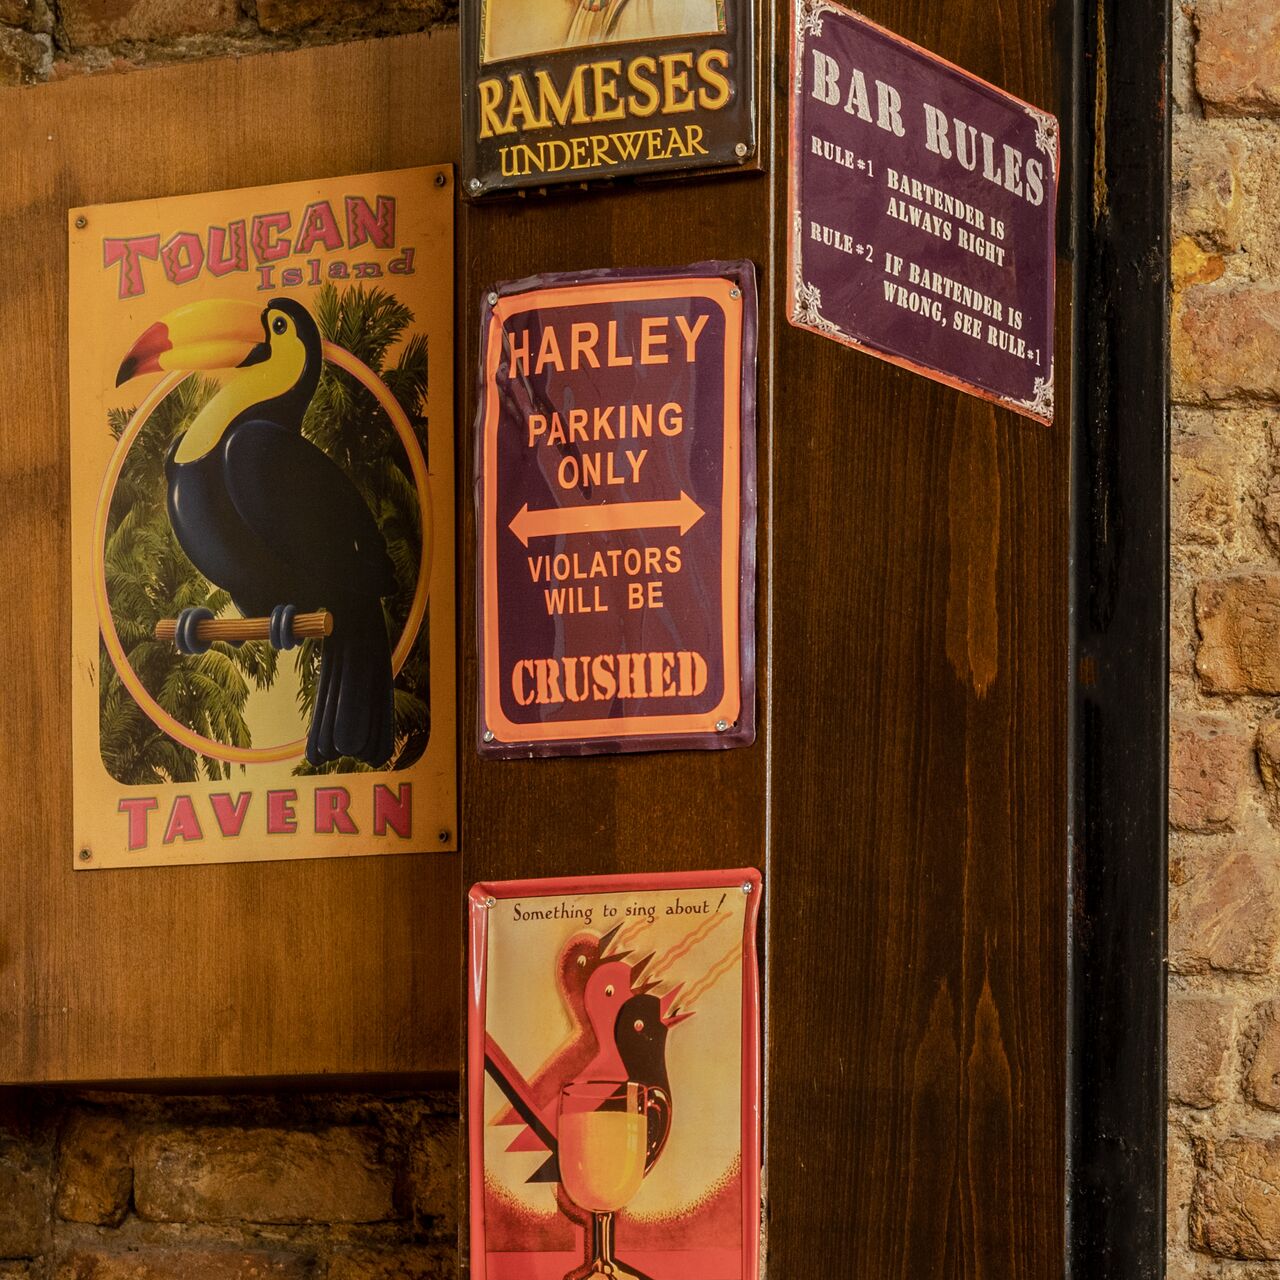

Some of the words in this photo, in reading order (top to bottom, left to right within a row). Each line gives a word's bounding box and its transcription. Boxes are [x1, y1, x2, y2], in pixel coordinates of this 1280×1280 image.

[478, 49, 732, 139] RAMESES
[499, 124, 709, 178] UNDERWEAR
[812, 48, 906, 138] BAR
[922, 102, 1045, 207] RULES
[886, 167, 986, 232] BARTENDER
[989, 216, 1006, 241] IS
[886, 197, 952, 242] ALWAYS
[957, 227, 1006, 268] RIGHT
[102, 194, 397, 300] TOUCAN
[256, 247, 417, 292] Island
[883, 280, 948, 328] WRONG,
[952, 311, 982, 340] SEE
[884, 251, 904, 276] IF
[908, 262, 1003, 322] BARTENDER
[1007, 306, 1023, 330] IS
[508, 314, 710, 379] HARLEY
[528, 402, 684, 448] PARKING
[557, 449, 648, 490] ONLY
[527, 545, 683, 583] VIOLATORS
[544, 585, 609, 616] WILL
[627, 581, 664, 610] BE
[511, 651, 708, 707] CRUSHED
[117, 782, 413, 851] TAVERN
[513, 902, 594, 926] Something
[602, 904, 618, 918] to
[625, 902, 657, 924] sing
